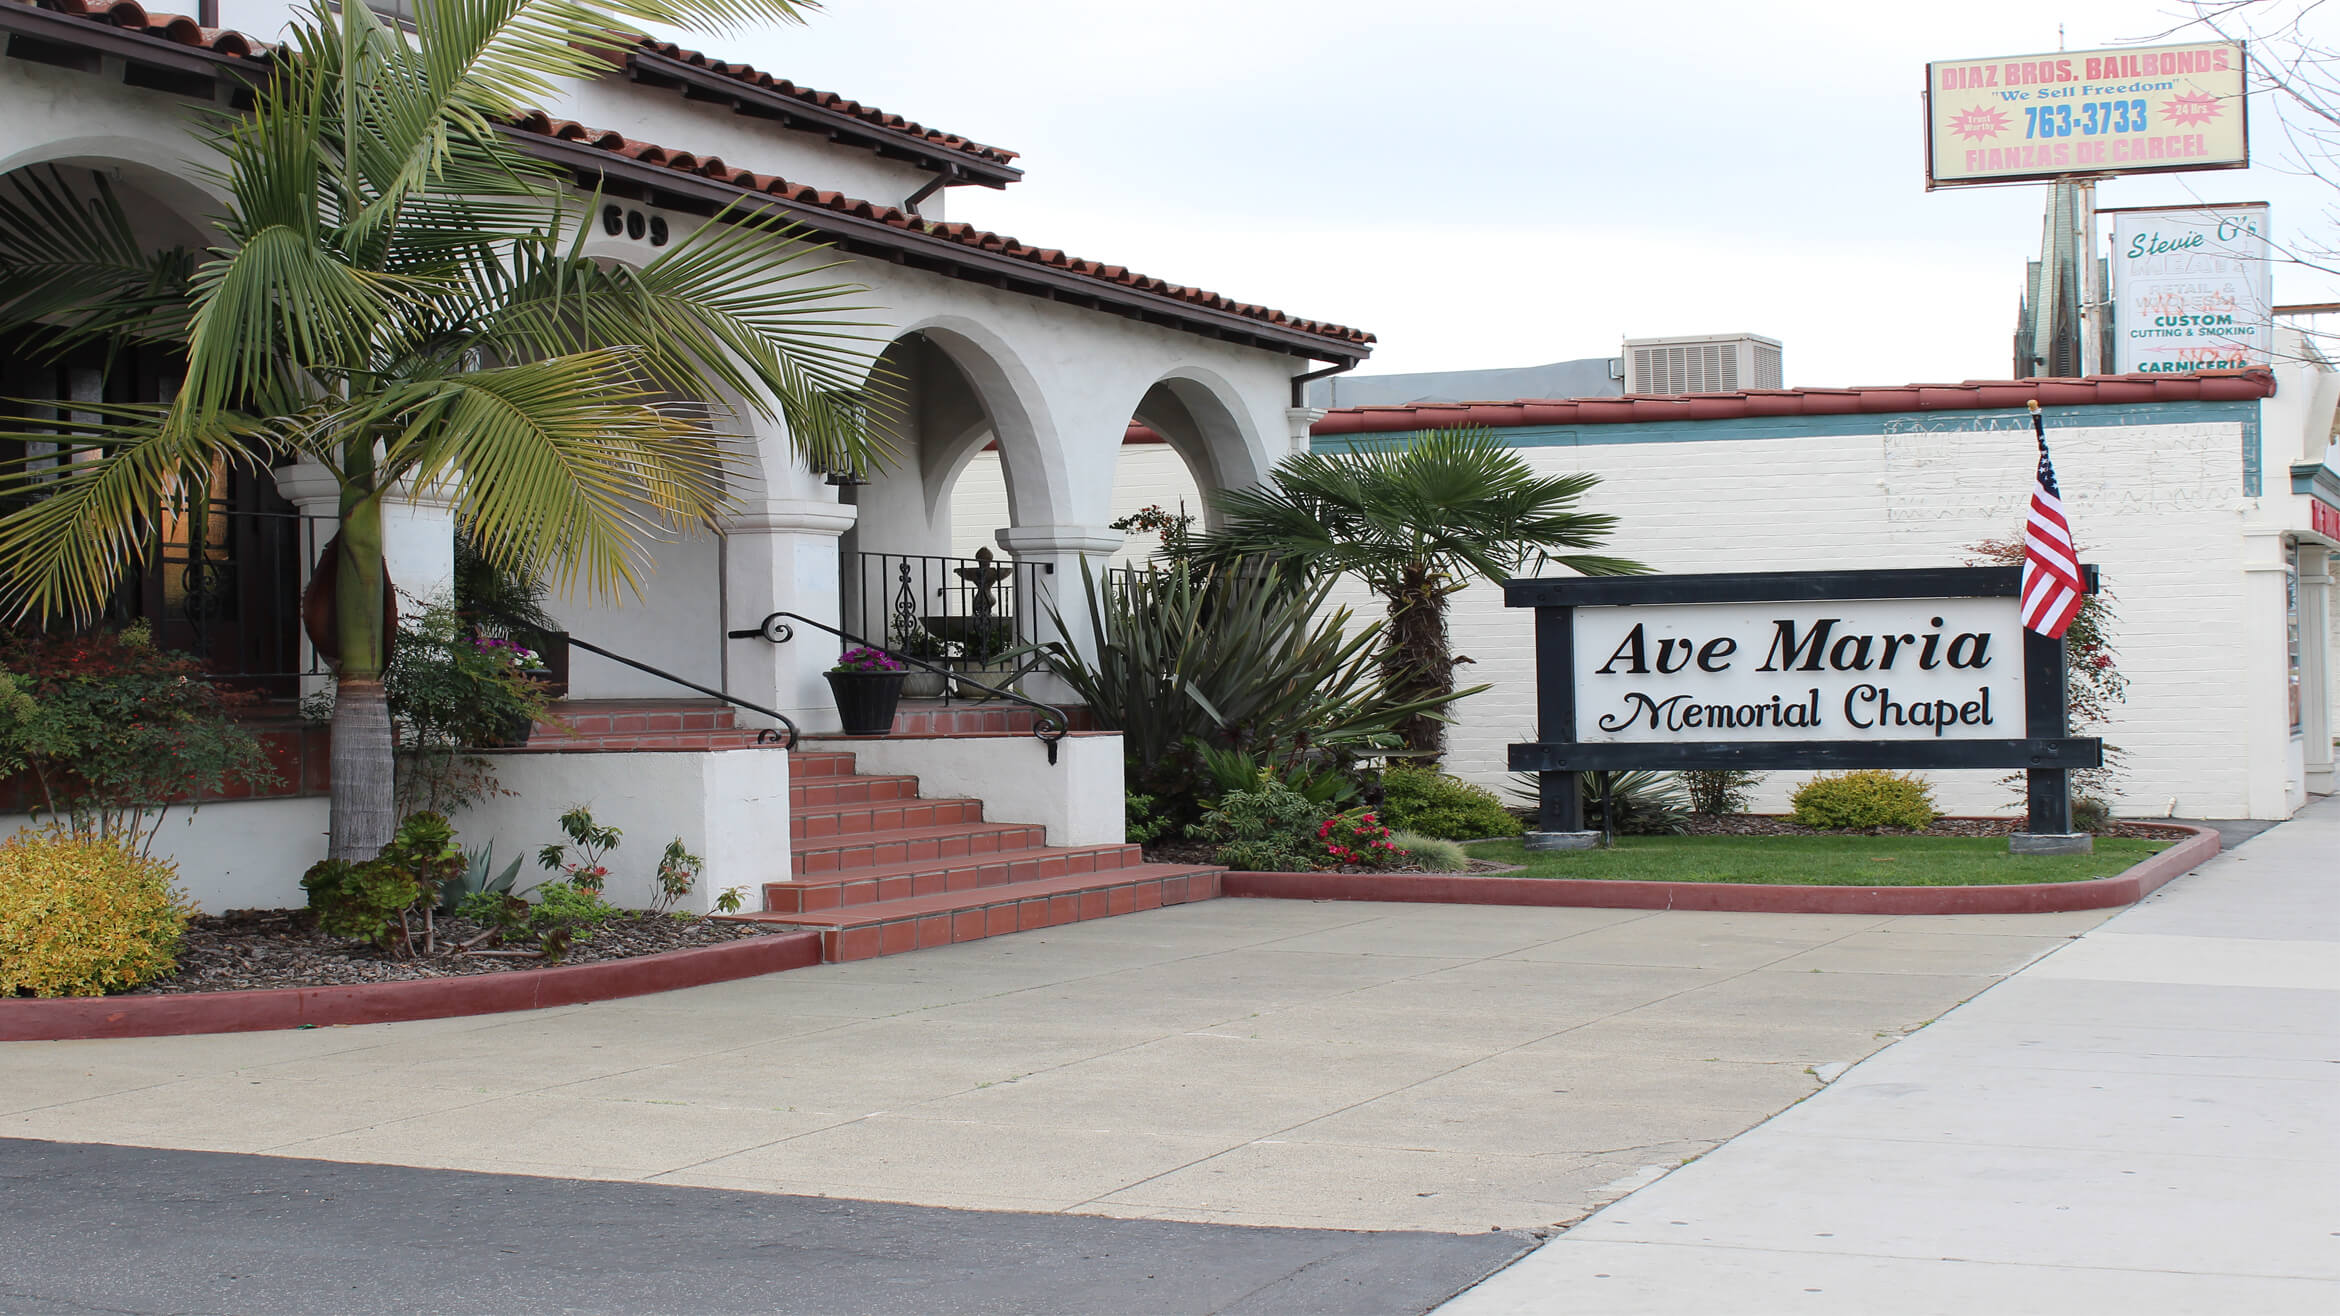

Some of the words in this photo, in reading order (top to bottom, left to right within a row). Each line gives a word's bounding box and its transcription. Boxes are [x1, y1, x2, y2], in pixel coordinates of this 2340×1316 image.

[1941, 65, 1998, 90] DIAZ
[2005, 59, 2080, 85] BROS.
[2086, 49, 2229, 80] BAILBONDS
[2037, 86, 2075, 99] Sell
[2024, 99, 2147, 139] 763-3733
[1965, 143, 2069, 172] FIANZAS
[2076, 140, 2105, 164] DE
[2111, 134, 2209, 163] CARCEL
[603, 204, 669, 247] 609
[2127, 230, 2205, 259] Stevie
[2130, 327, 2182, 339] CUTTING
[2186, 327, 2195, 337] &
[2199, 326, 2256, 337] SMOKING
[2154, 314, 2233, 327] CUSTOM
[1595, 622, 1738, 674] Ave
[1755, 616, 1993, 673] Maria
[1598, 687, 1822, 733] Memorial
[1843, 683, 1994, 738] Chapel
